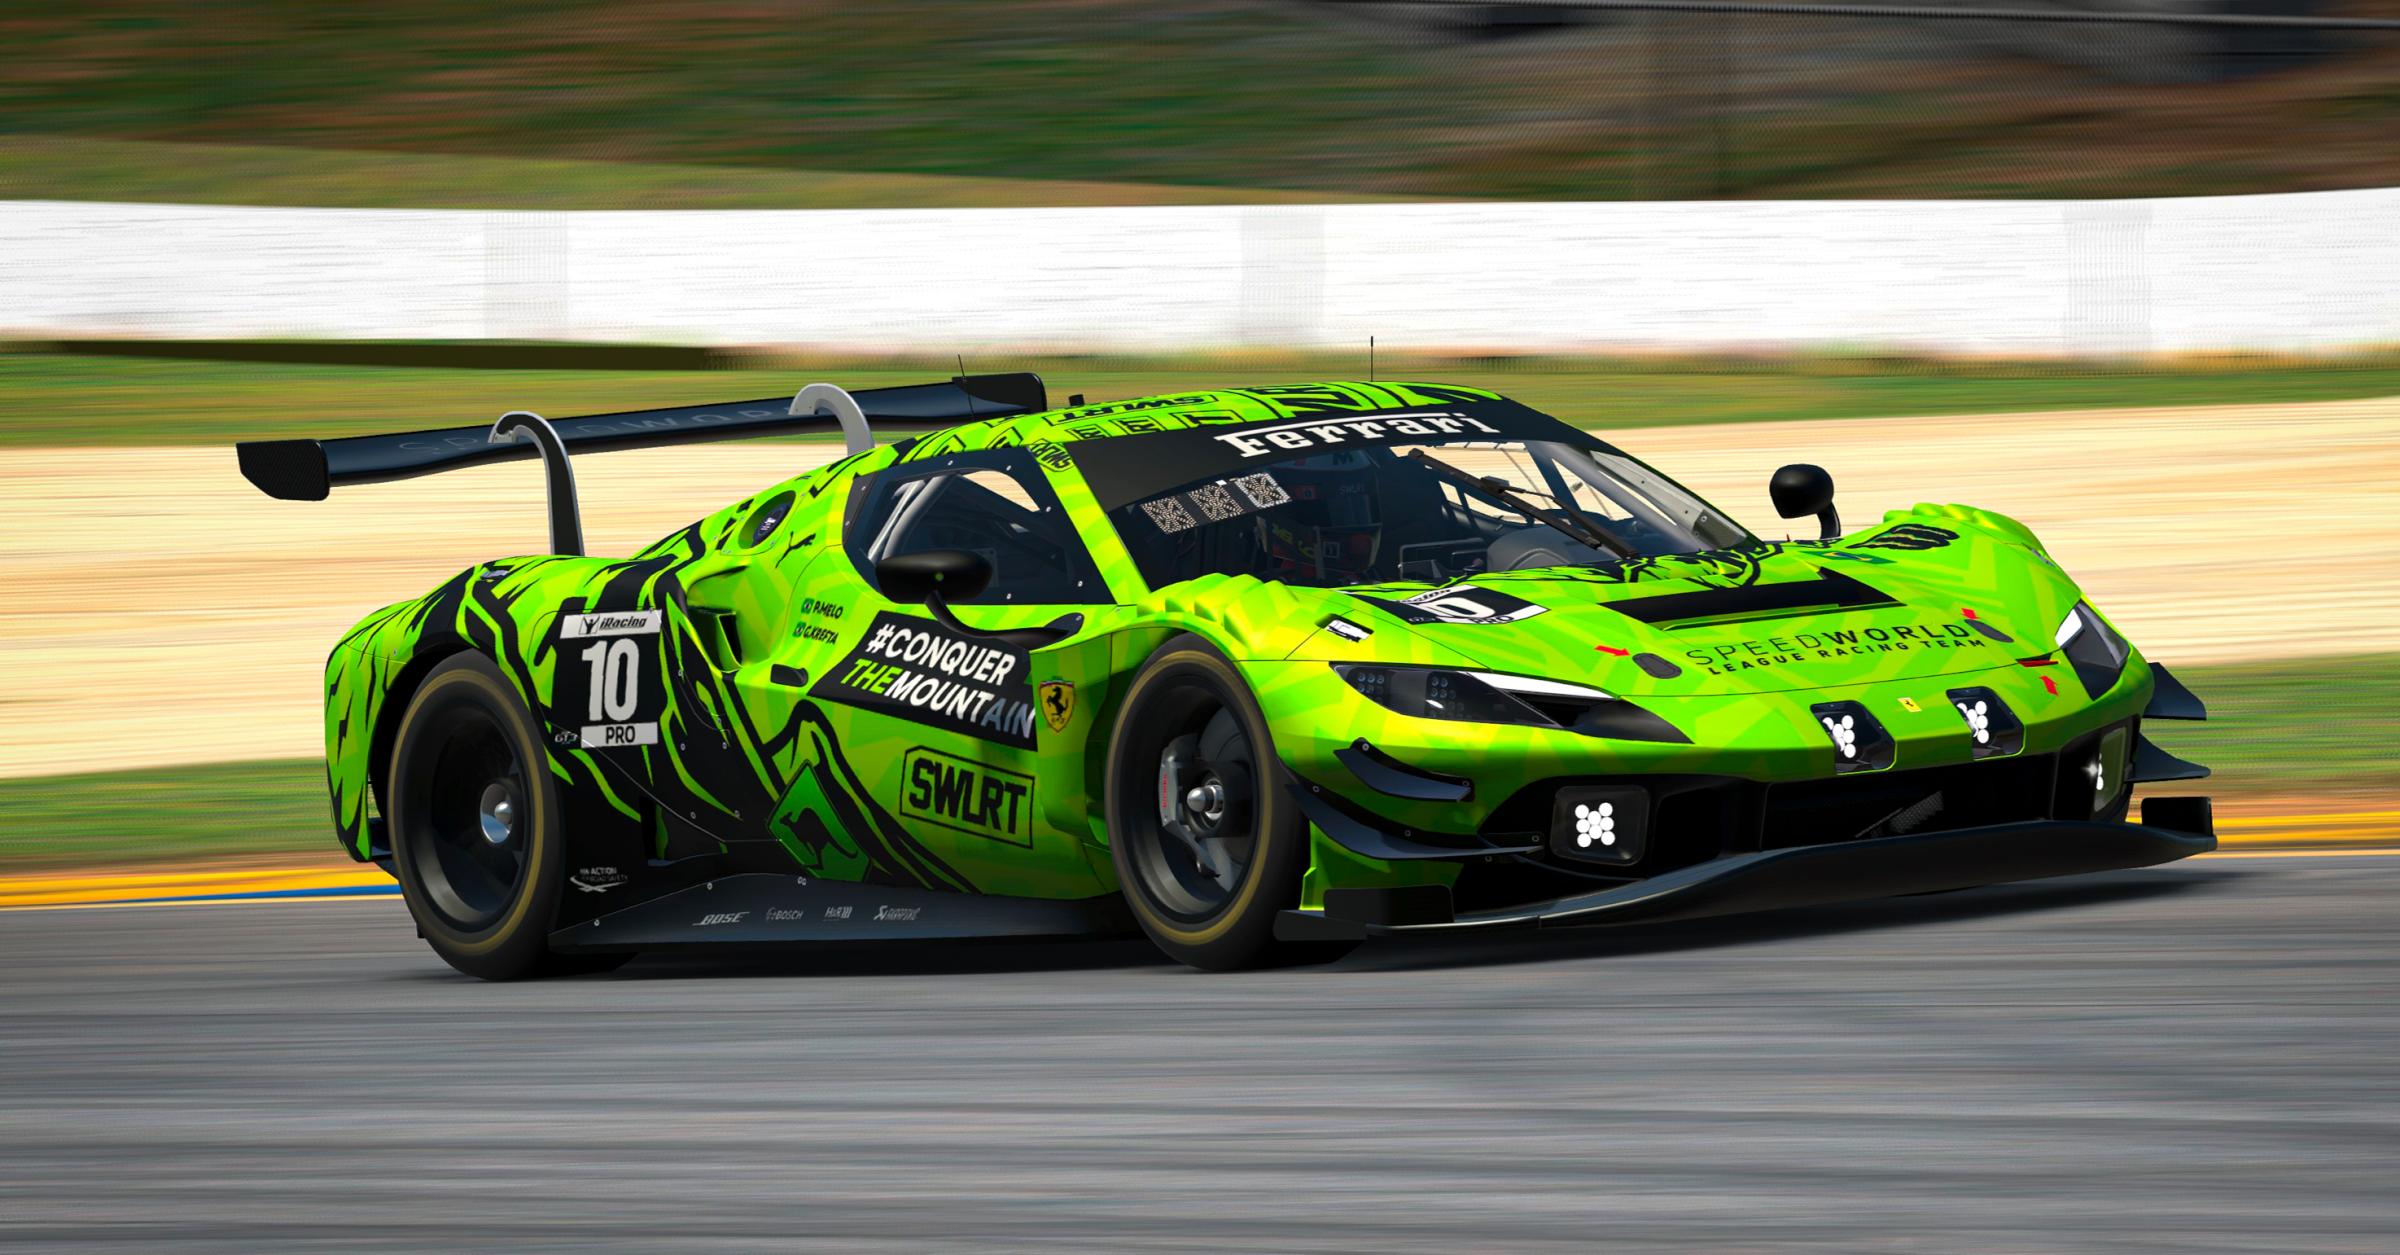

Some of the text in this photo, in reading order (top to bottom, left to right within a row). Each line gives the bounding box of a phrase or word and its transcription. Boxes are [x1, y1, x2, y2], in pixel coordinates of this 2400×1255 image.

[1213, 412, 1501, 458] Ferrari
[599, 615, 648, 629] iRacing
[812, 600, 843, 619] P.MELO
[866, 623, 1016, 686] #CONQUER
[1686, 623, 1970, 666] SPEEDWORLD
[1708, 639, 1985, 676] LEAGUE RACING TEAM
[581, 637, 640, 723] 10
[605, 725, 636, 744] PRO
[908, 757, 1027, 835] SWLRT
[692, 911, 750, 926] BOSE
[775, 909, 804, 921] BOSCH
